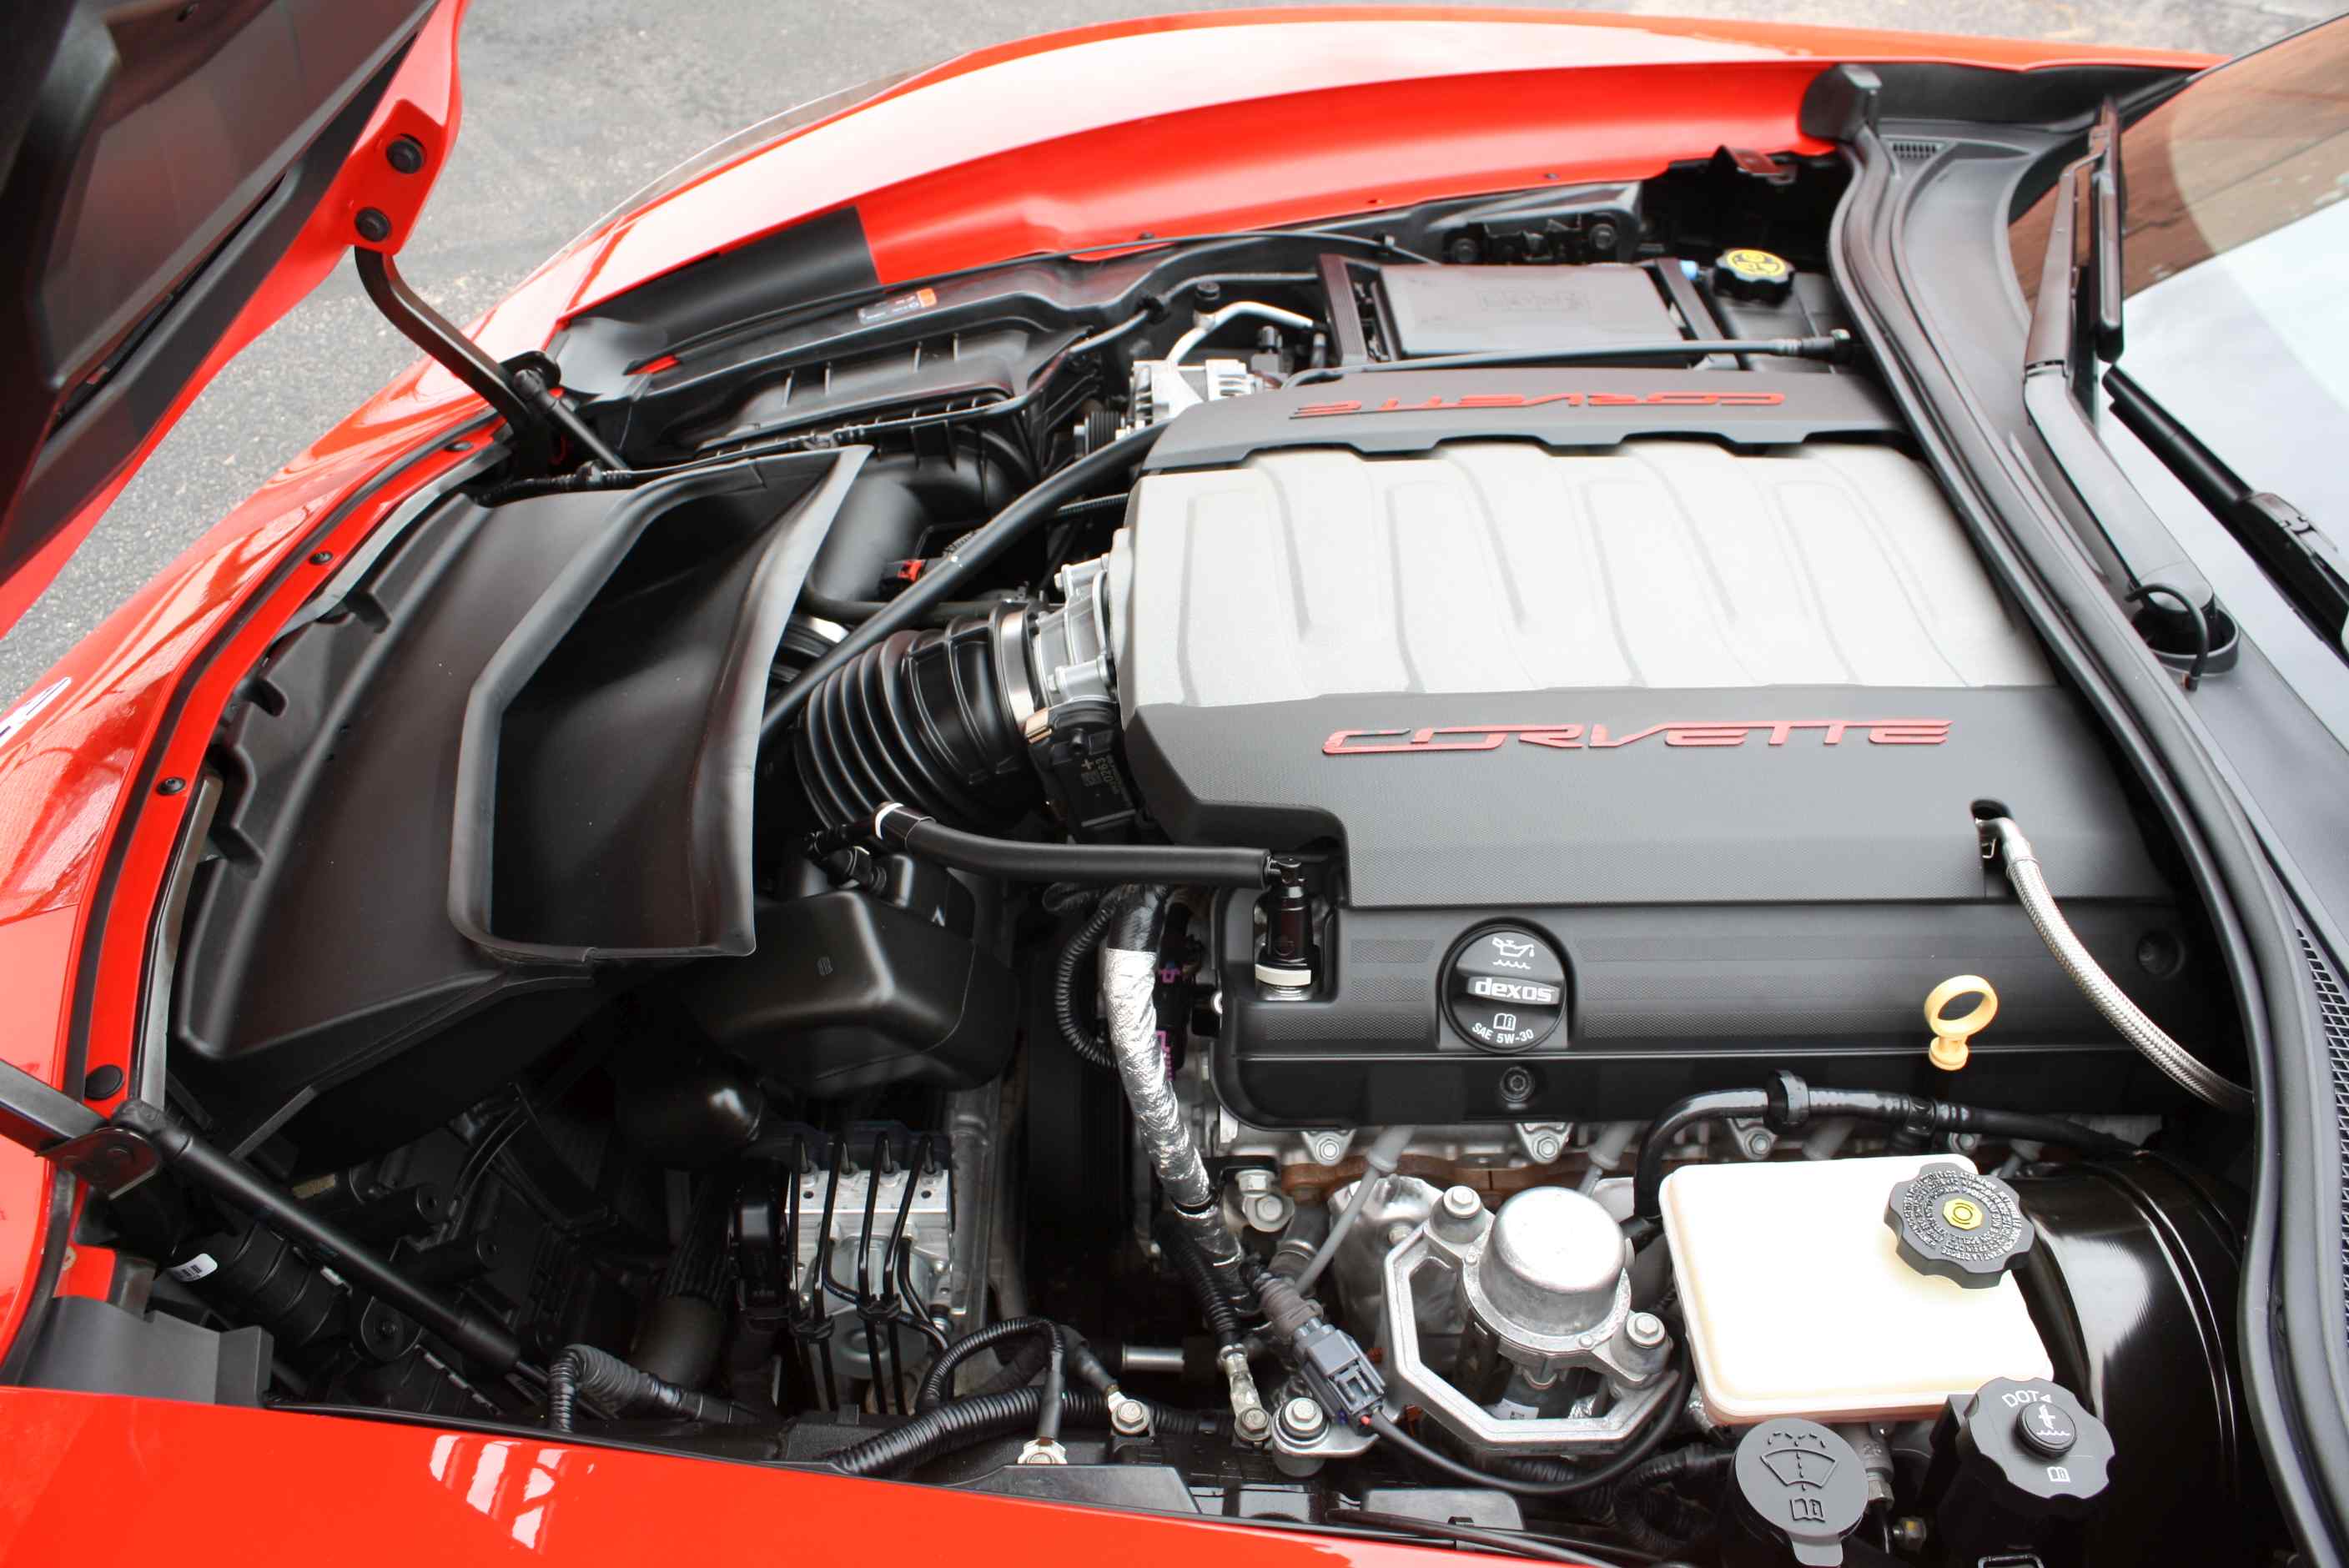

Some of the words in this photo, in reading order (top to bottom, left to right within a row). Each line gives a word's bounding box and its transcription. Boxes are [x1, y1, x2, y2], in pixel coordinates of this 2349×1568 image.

[1289, 392, 1785, 419] CORVETTE
[1322, 718, 1953, 754] CORVETTE
[1474, 977, 1556, 1003] dexos
[1471, 1022, 1494, 1041] SAE
[1496, 1028, 1534, 1044] 5W-30
